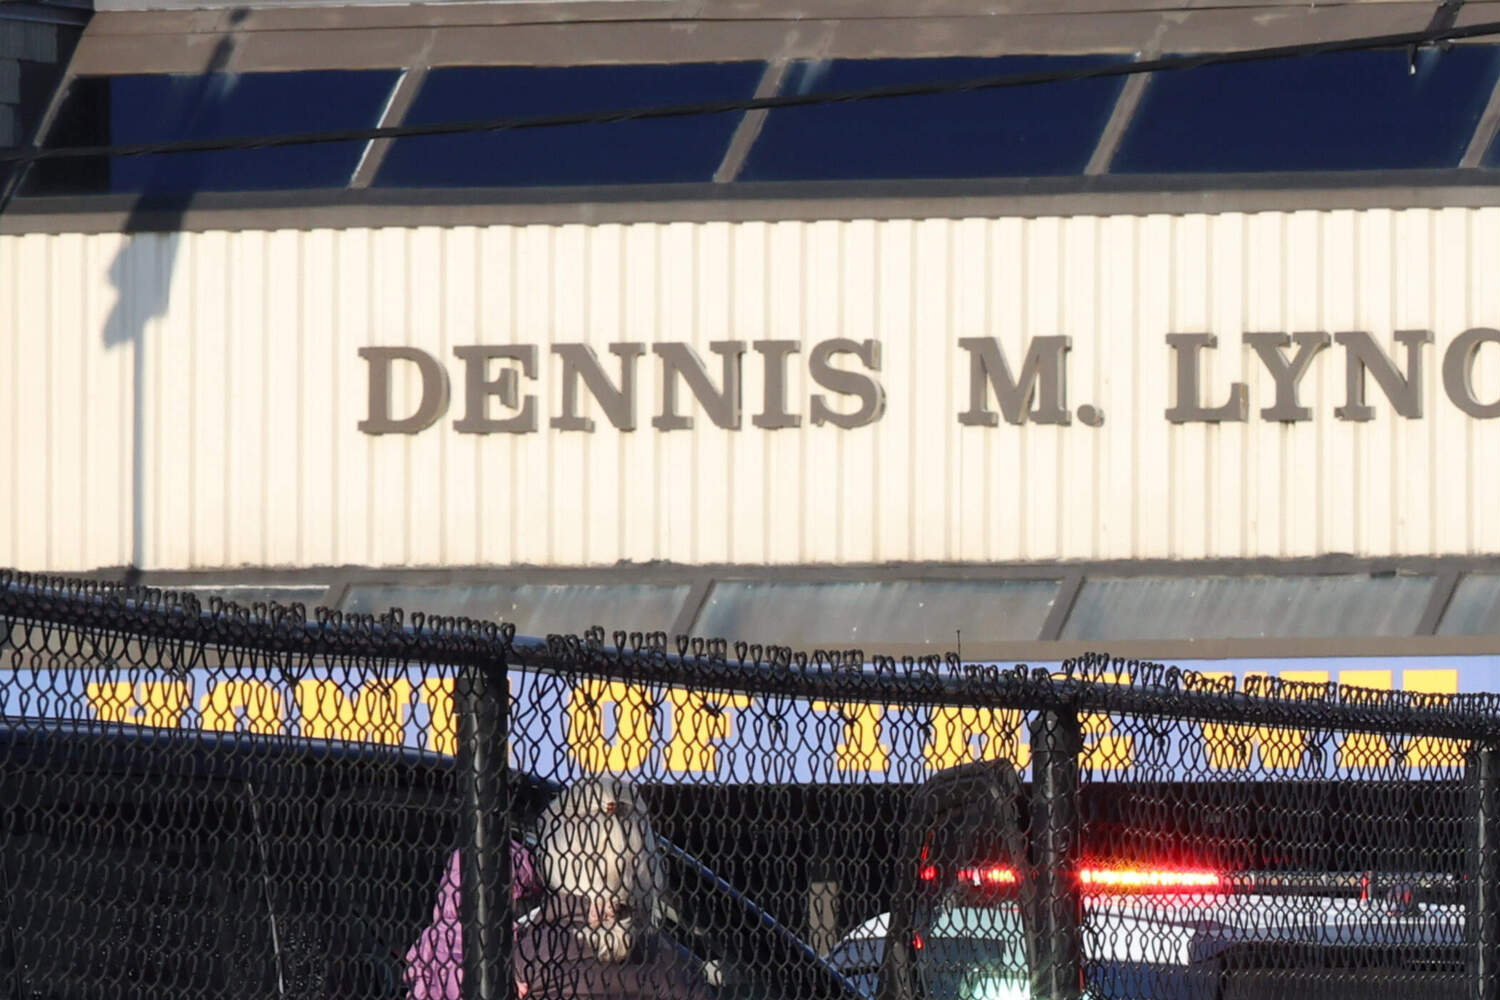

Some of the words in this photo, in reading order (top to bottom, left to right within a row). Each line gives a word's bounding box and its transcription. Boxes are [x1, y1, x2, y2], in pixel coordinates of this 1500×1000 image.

[358, 338, 887, 435] DENNIS
[958, 334, 1105, 427] M.
[567, 678, 757, 772] OF
